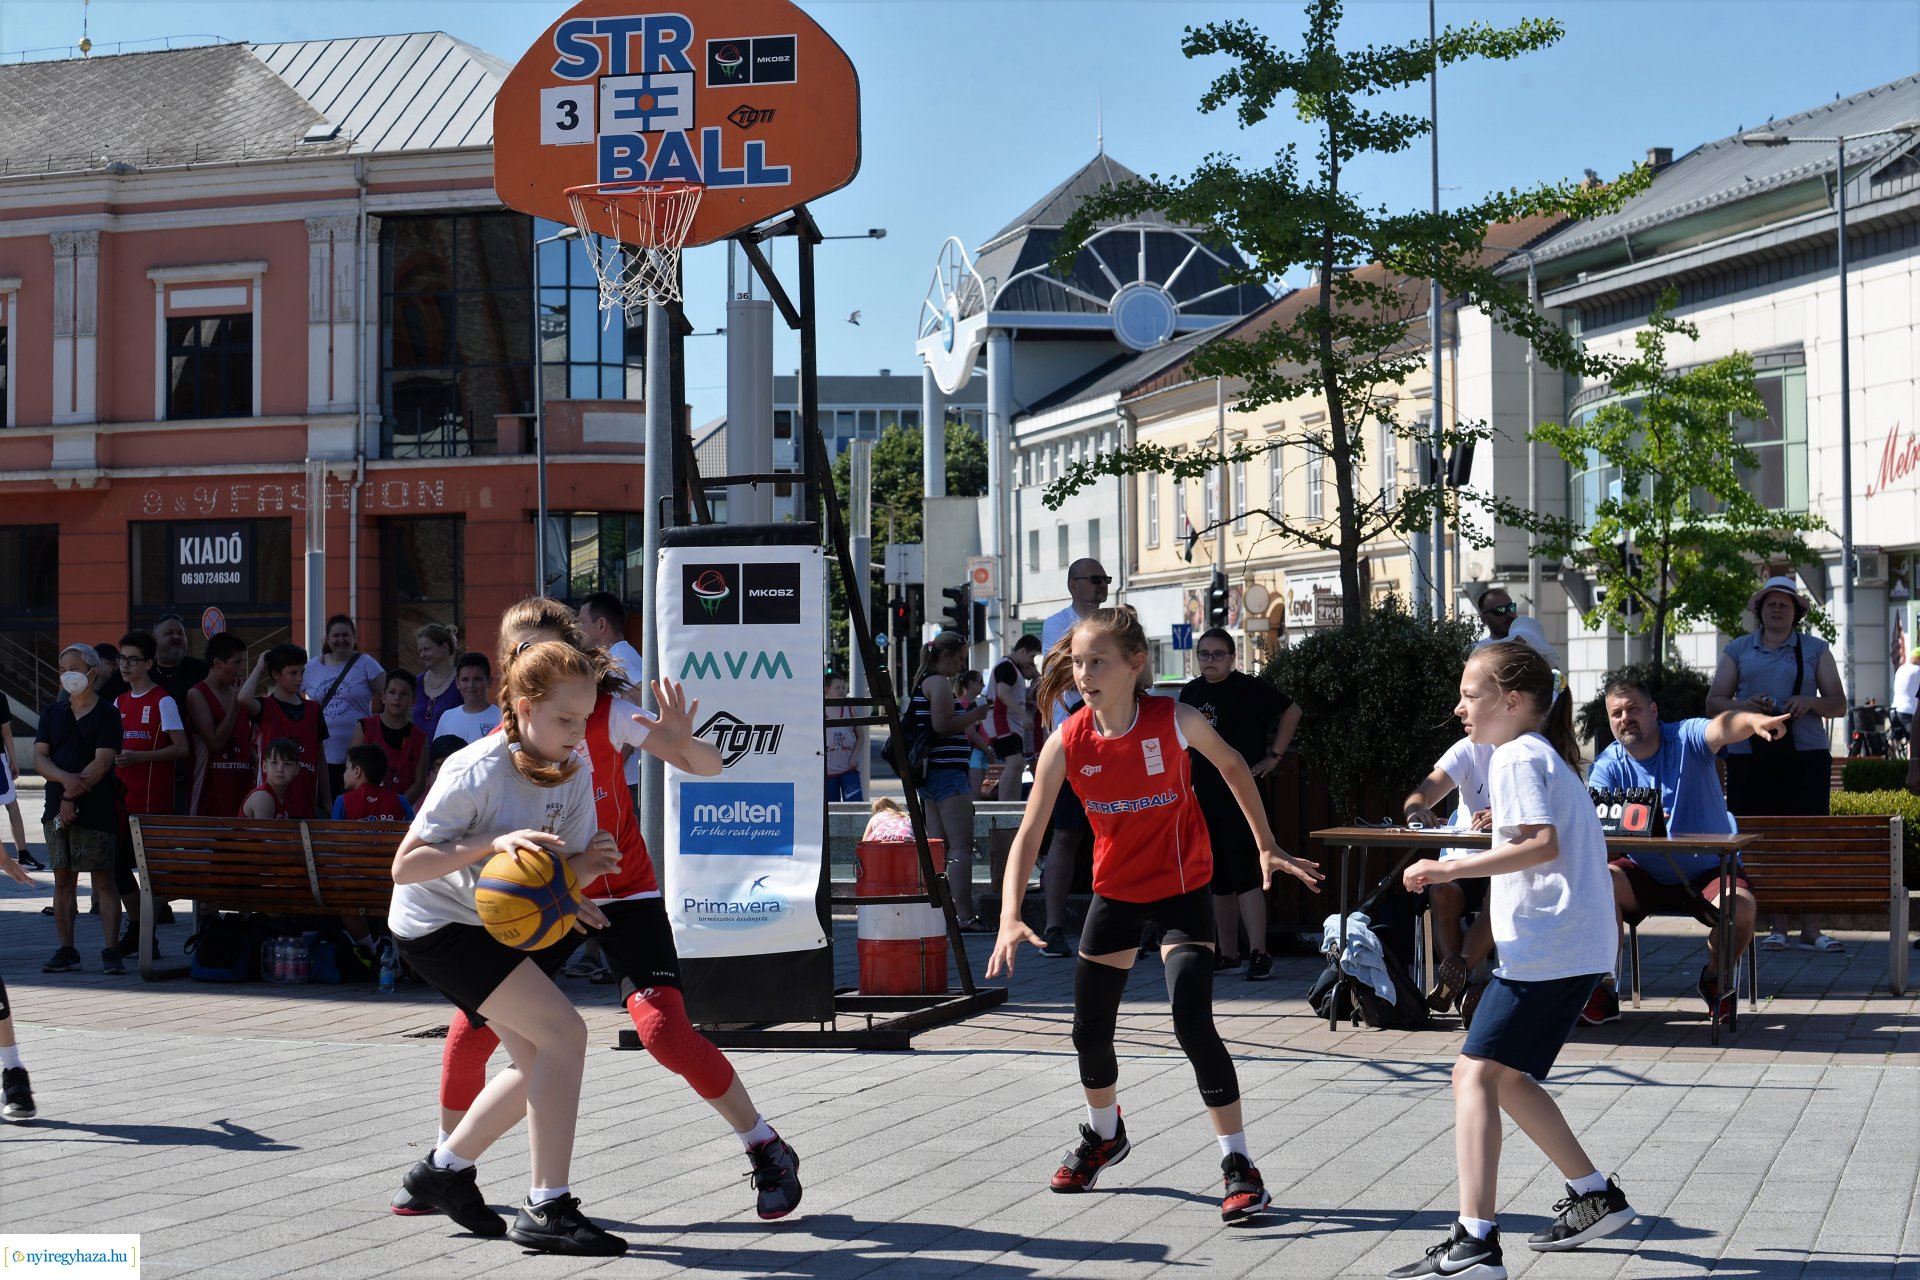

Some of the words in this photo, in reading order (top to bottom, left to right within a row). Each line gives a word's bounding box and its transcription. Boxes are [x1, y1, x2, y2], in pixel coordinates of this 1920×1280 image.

[551, 12, 696, 81] STR
[757, 55, 790, 63] MKOSZ
[556, 100, 580, 131] 3
[739, 109, 776, 124] TOTI
[597, 126, 791, 194] BALL
[737, 292, 749, 300] 36
[230, 480, 444, 512] FASHION
[180, 532, 242, 565] KIADÓ
[749, 588, 794, 597] MKOSZ
[680, 651, 793, 679] MVM
[712, 724, 784, 754] TOTI
[693, 801, 781, 823] molten
[1085, 788, 1178, 814] STREETBALL
[690, 825, 709, 837] For
[709, 825, 727, 836] the
[727, 825, 751, 836] real
[750, 829, 781, 840] game
[684, 898, 781, 914] Primavera
